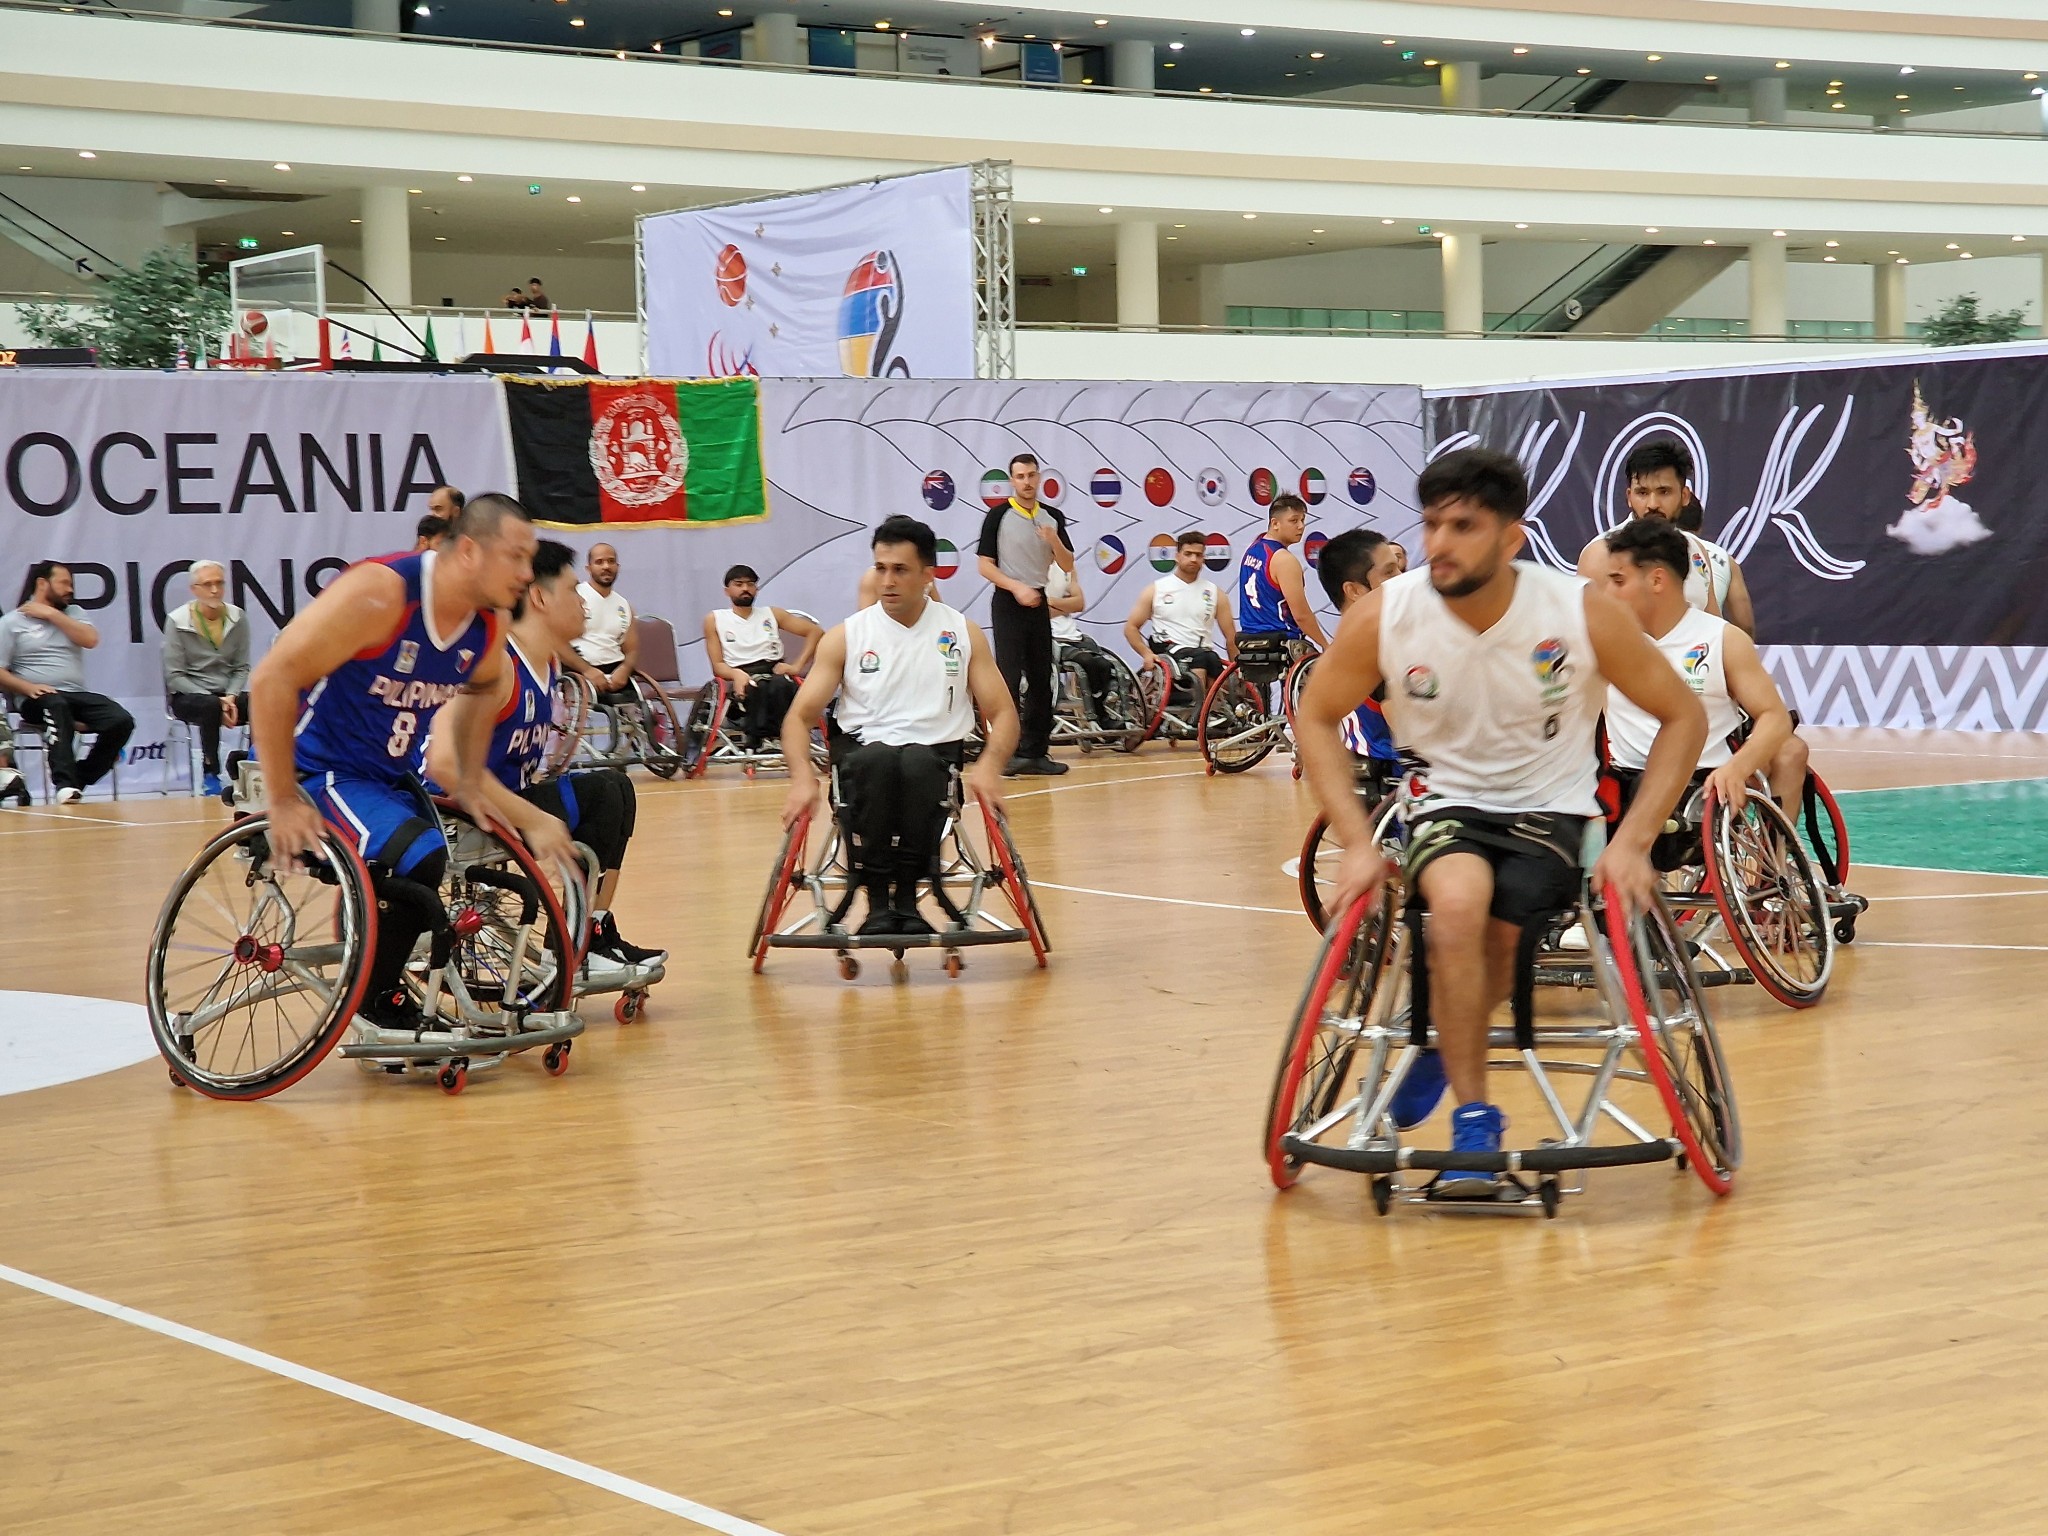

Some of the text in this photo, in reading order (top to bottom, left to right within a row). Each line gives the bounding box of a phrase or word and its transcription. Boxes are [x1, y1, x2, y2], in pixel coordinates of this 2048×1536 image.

[6, 431, 450, 517] OCEANIA
[0, 556, 352, 645] PION
[1244, 572, 1261, 609] 4
[946, 685, 955, 714] 1
[127, 741, 167, 766] ptt
[387, 710, 417, 758] 8
